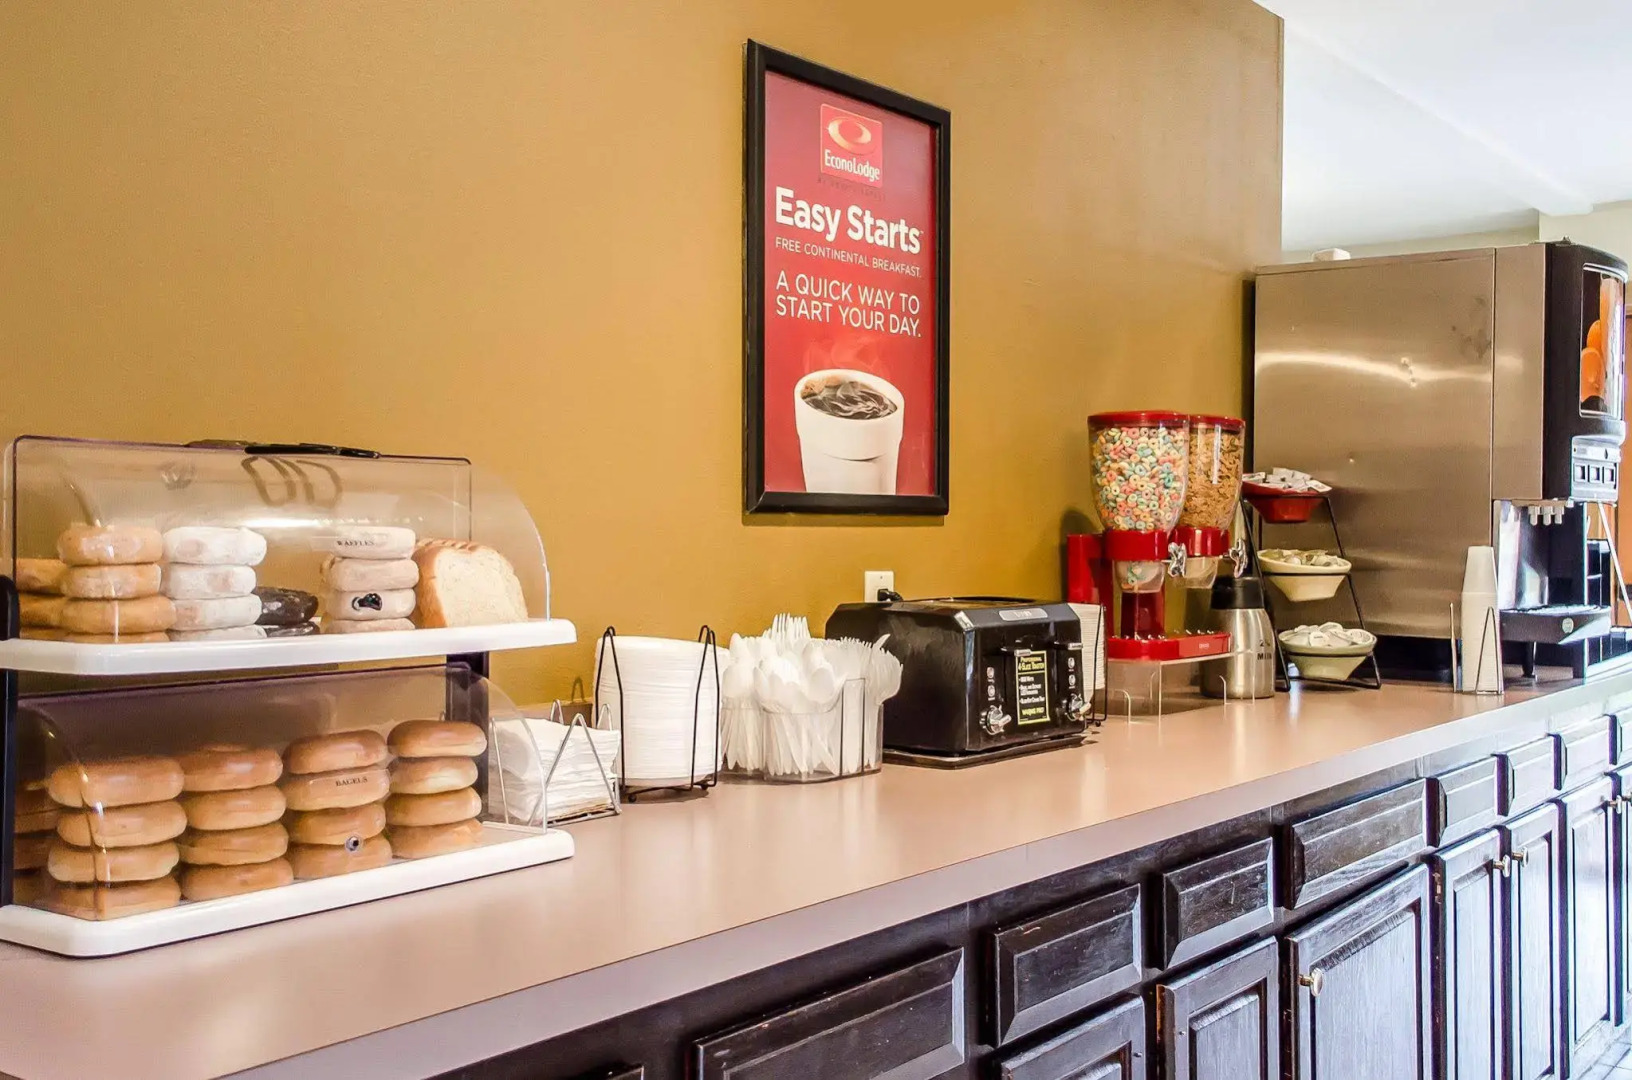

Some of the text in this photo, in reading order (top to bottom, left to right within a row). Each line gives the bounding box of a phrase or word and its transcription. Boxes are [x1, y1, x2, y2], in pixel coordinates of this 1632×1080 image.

[824, 148, 881, 182] EconoLodge
[775, 186, 842, 242] Easy
[775, 237, 801, 253] FREE
[804, 243, 870, 268] CONTINENTAL
[776, 270, 920, 315] A QUICK WAY TO
[776, 295, 922, 338] START YOUR DAY.
[335, 776, 368, 786] BAGELS
